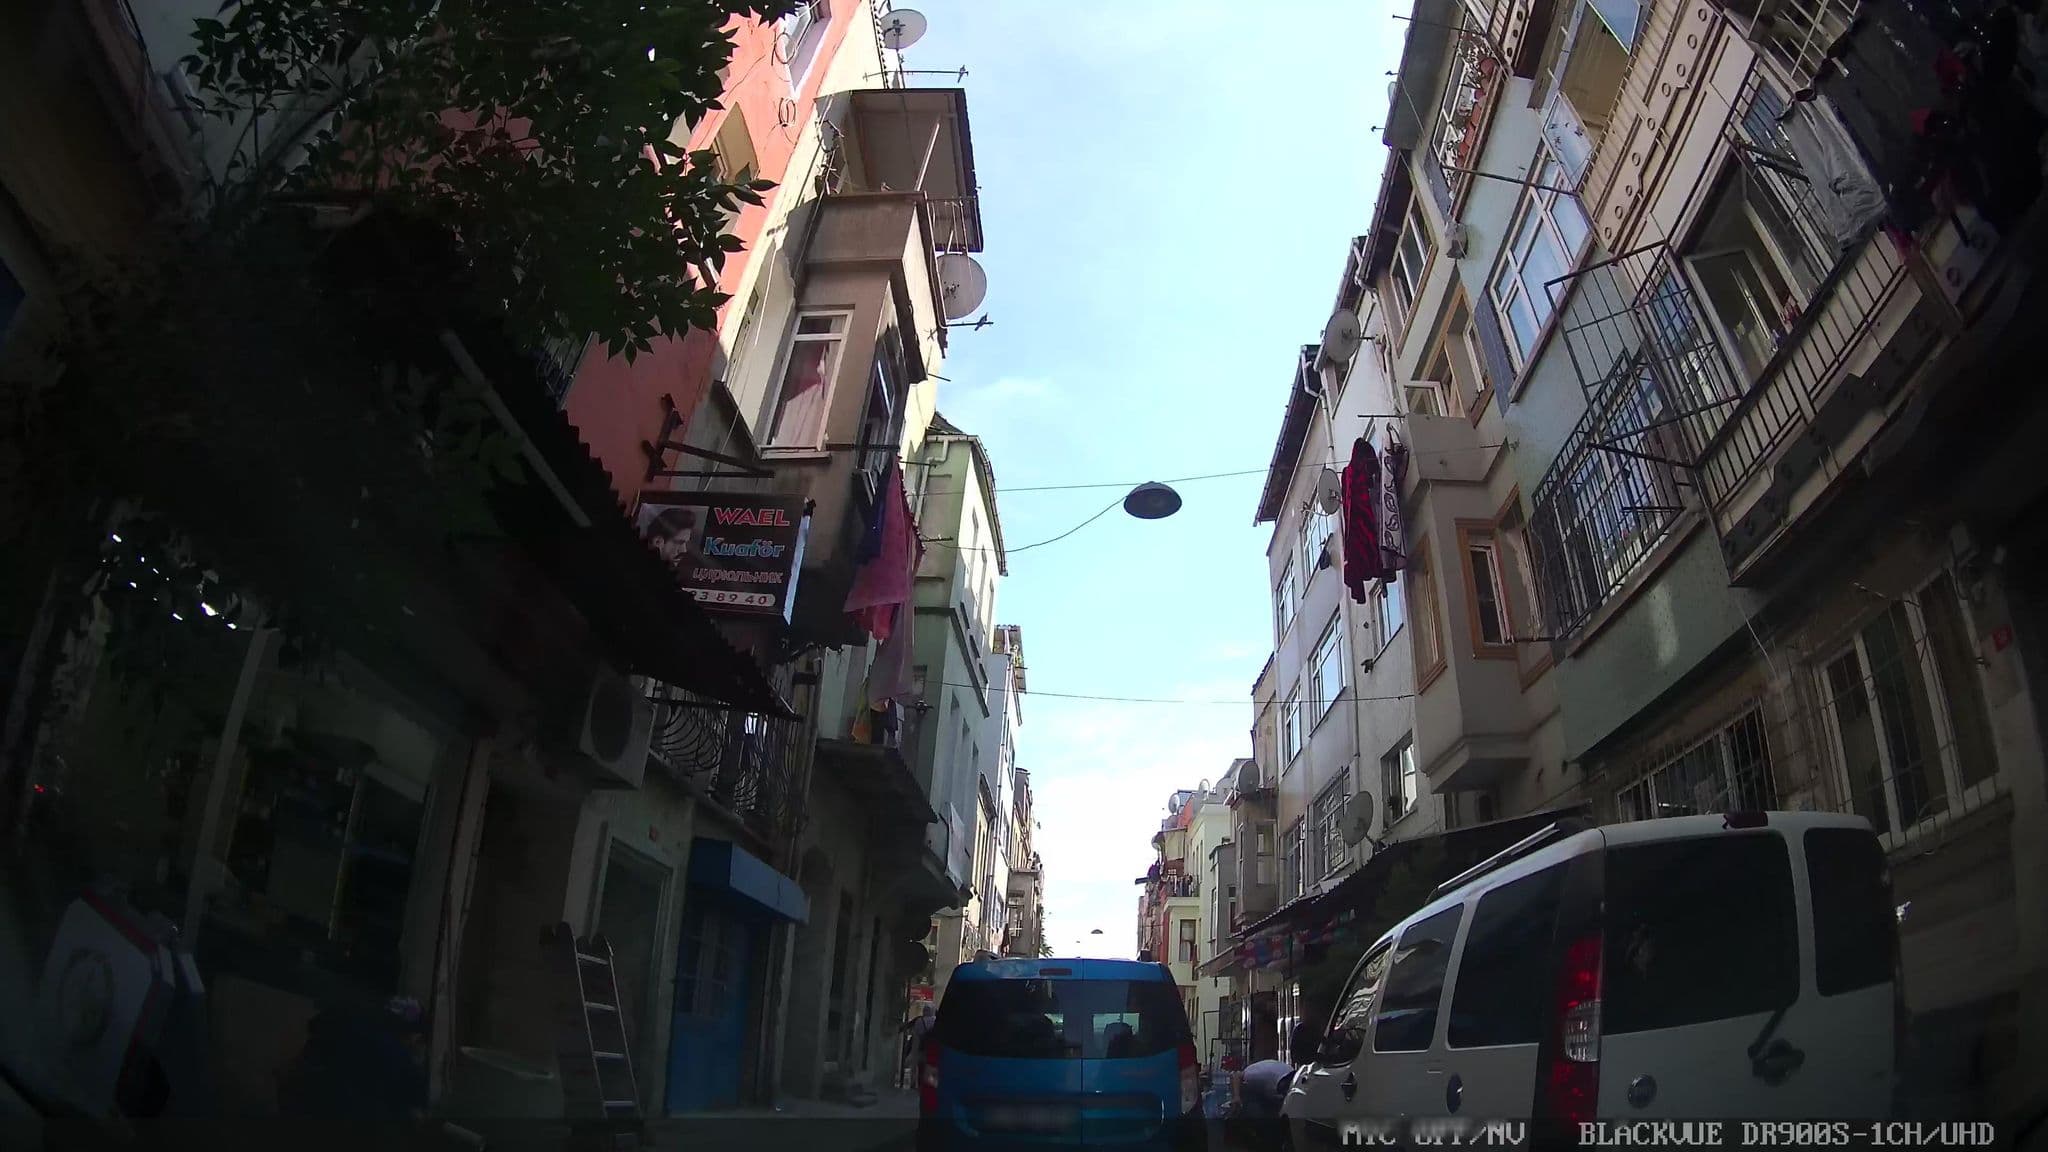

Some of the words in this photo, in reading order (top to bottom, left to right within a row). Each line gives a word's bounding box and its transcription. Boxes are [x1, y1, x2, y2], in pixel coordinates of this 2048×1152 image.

[713, 507, 790, 527] WAEL
[703, 536, 785, 557] Kuaför
[745, 595, 767, 605] 40
